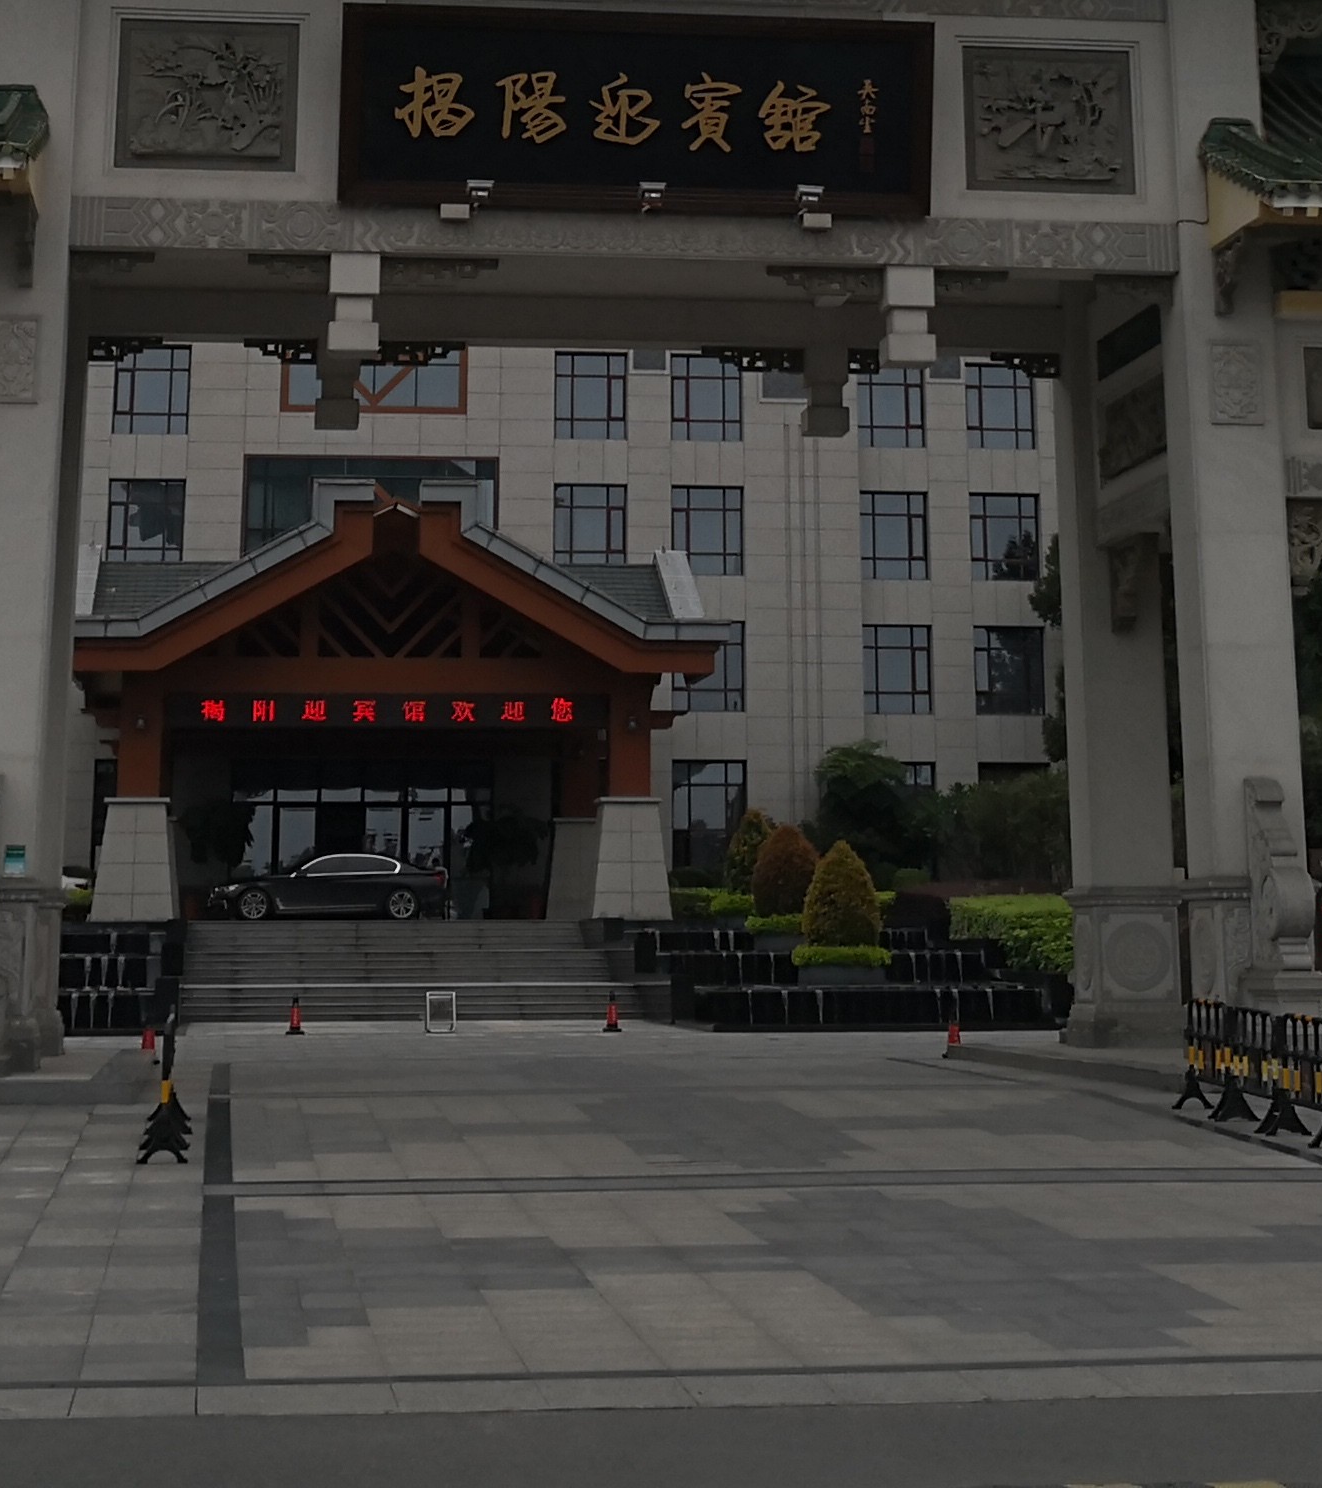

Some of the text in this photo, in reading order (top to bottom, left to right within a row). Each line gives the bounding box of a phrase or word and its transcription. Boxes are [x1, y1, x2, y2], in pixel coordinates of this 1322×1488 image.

[200, 698, 574, 723] 揭阳迎宾馆欢迎您
